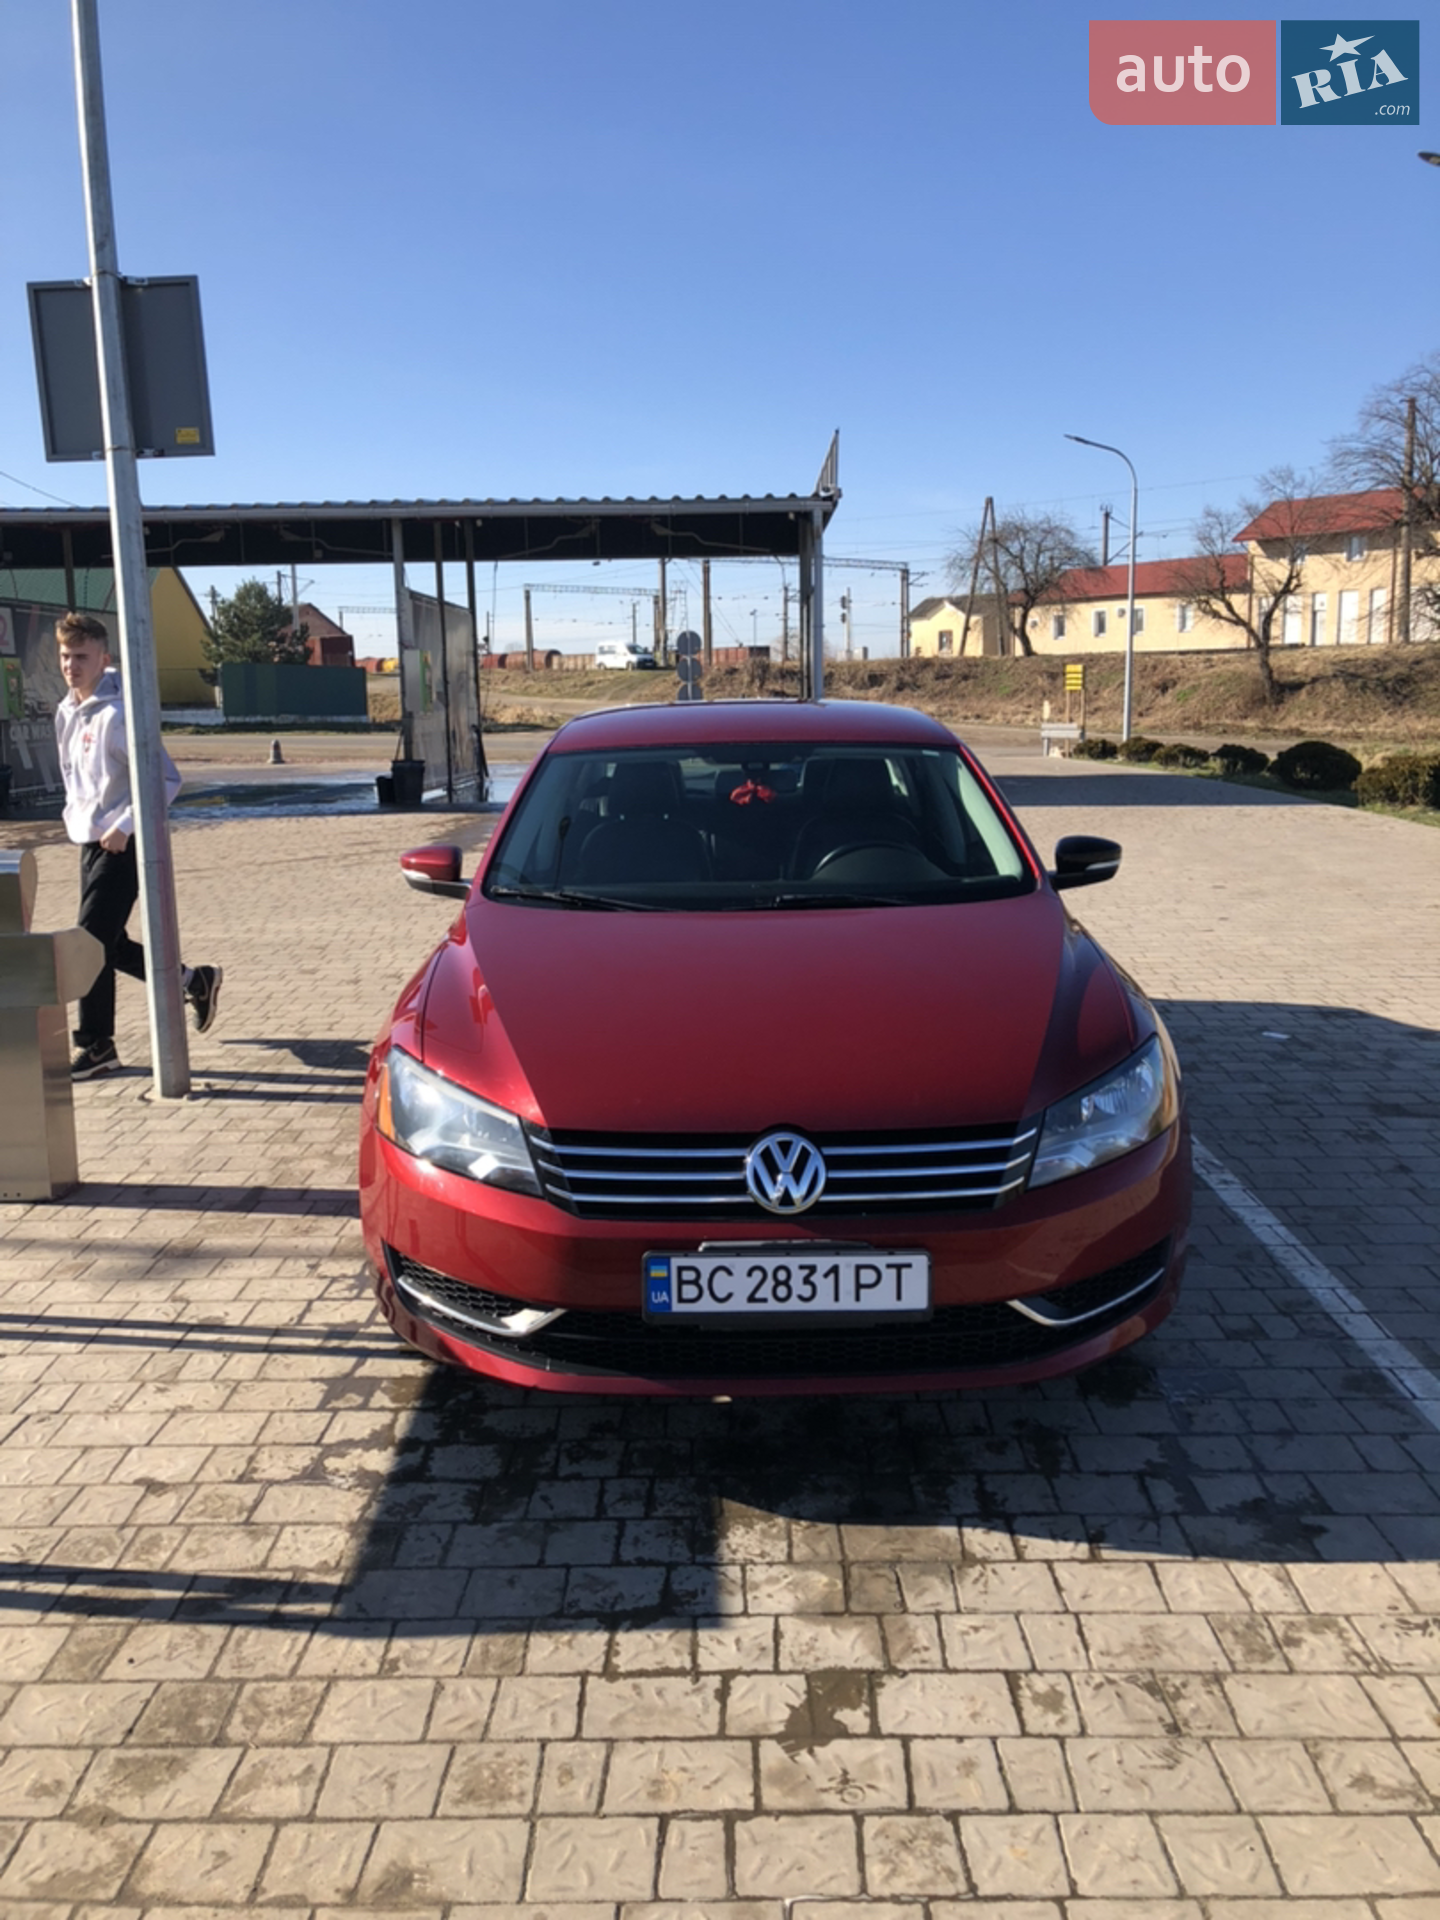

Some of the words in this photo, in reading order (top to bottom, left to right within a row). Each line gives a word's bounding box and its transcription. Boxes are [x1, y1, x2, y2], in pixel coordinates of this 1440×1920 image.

[31, 723, 54, 741] WAS
[676, 1265, 735, 1305] BC
[746, 1264, 841, 1304] 2831
[854, 1262, 913, 1303] PT
[651, 1291, 669, 1304] UA
